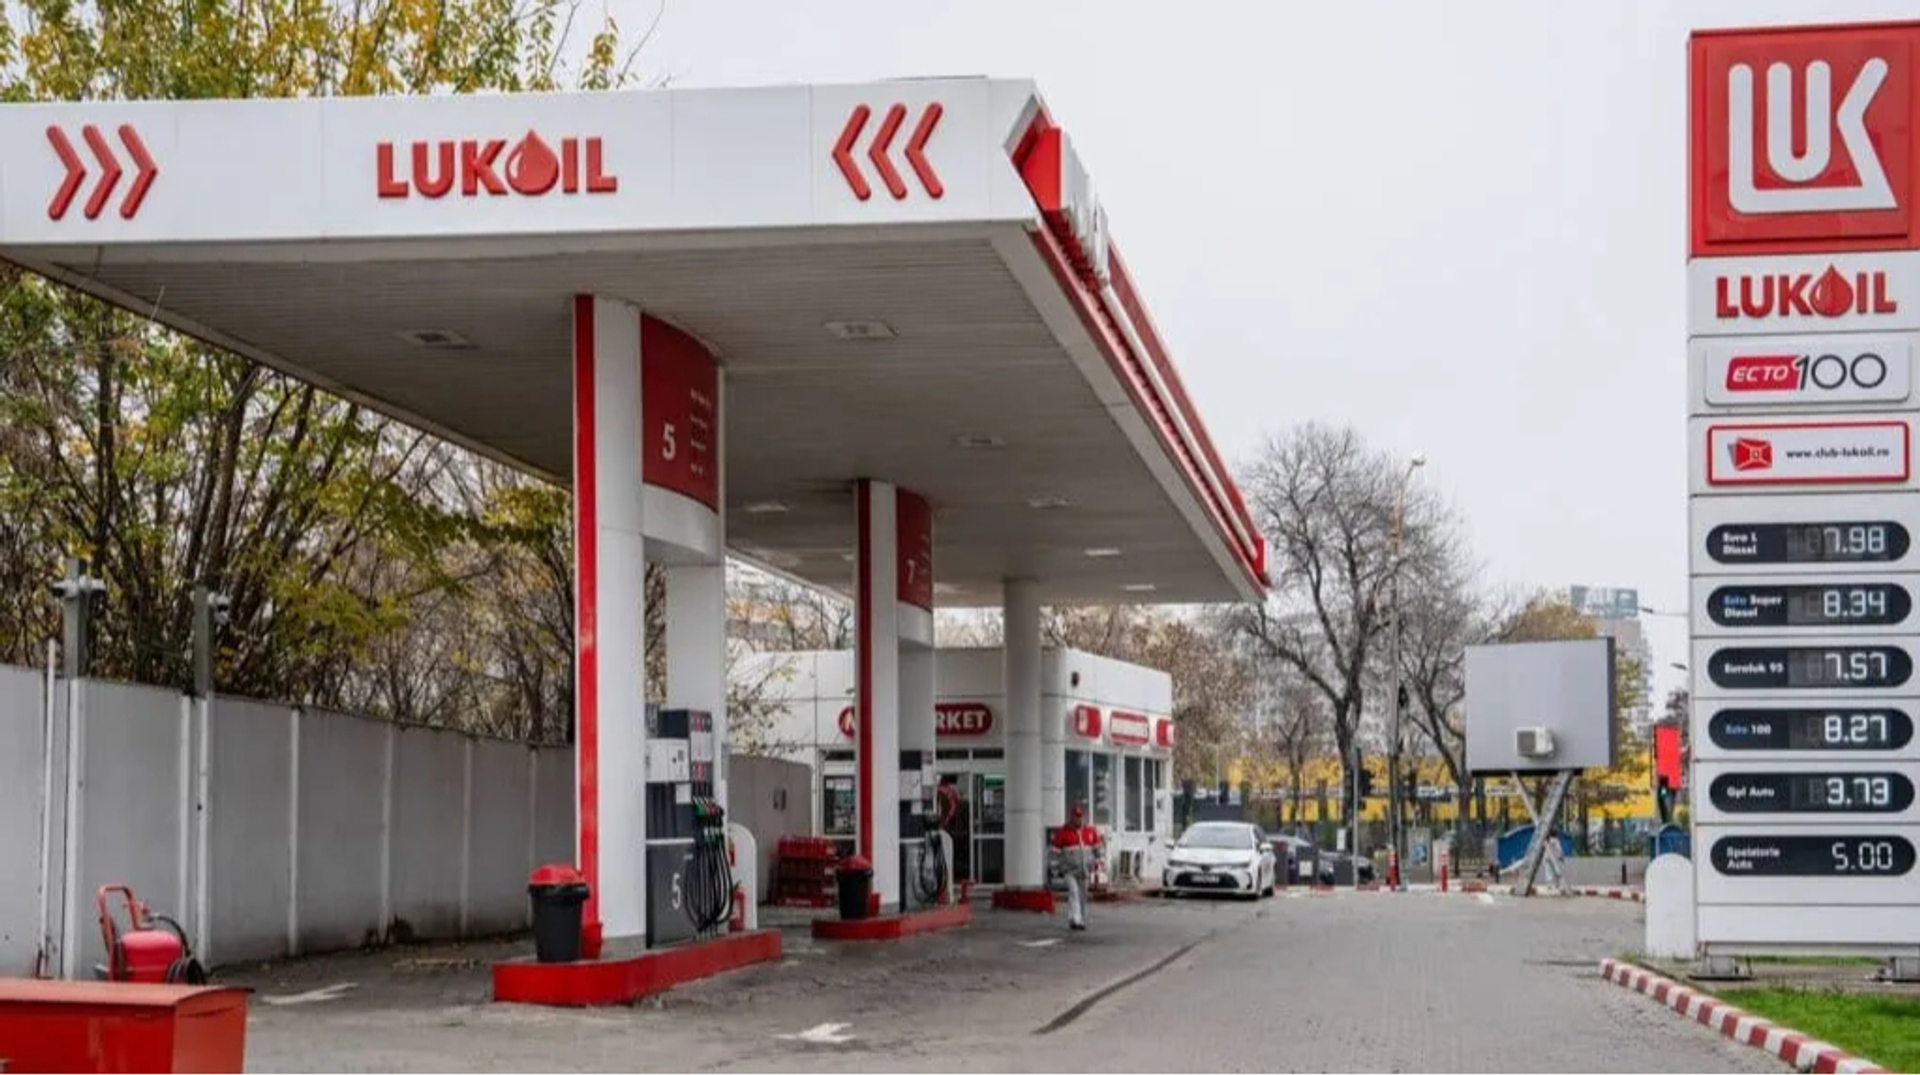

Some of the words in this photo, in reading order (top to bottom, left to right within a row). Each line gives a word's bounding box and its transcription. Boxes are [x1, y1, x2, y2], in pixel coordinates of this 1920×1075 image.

[1728, 57, 1898, 214] LUK
[377, 129, 617, 198] LUKOIL
[1716, 262, 1897, 318] LUKOIL
[662, 422, 676, 461] 5
[1723, 545, 1757, 555] Diesel
[1823, 526, 1885, 554] 7.98
[1725, 607, 1758, 618] Diesel
[1823, 590, 1886, 617] 8.34
[1824, 652, 1887, 679] 7.57
[1750, 724, 1772, 735] 100
[1824, 715, 1887, 742] 8.27
[1749, 786, 1775, 797] Auto
[1826, 778, 1889, 805] 3.73
[1726, 860, 1753, 869] Auto
[1831, 843, 1893, 870] 5.00
[671, 872, 681, 910] 5
